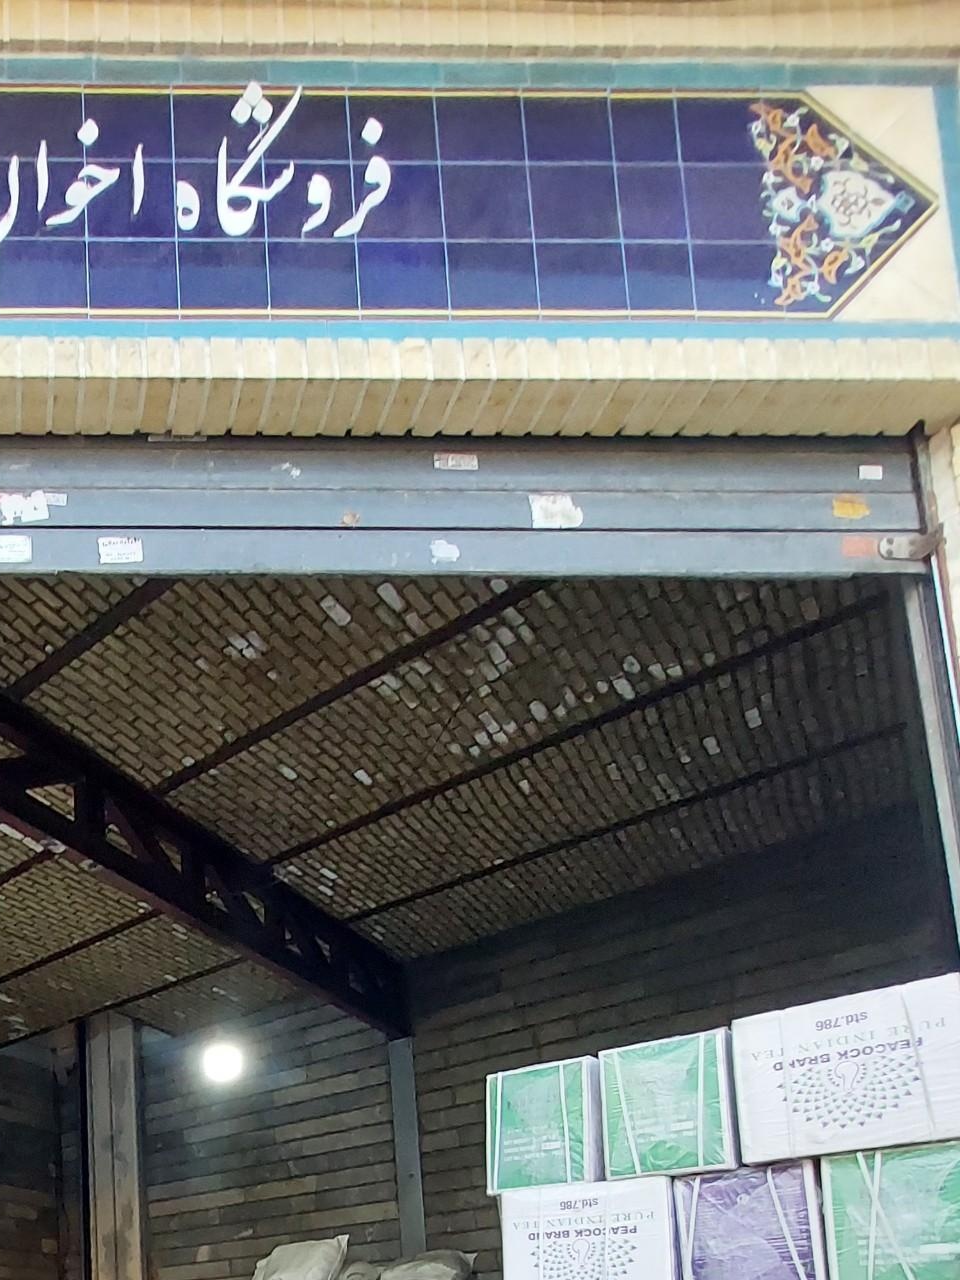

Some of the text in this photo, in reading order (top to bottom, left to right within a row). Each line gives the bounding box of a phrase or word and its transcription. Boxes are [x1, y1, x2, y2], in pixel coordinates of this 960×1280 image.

[176, 80, 394, 239] فروشگاه
[815, 1011, 868, 1032] std.786
[799, 1031, 876, 1052] INDIAN
[751, 1048, 785, 1062] TEA
[559, 1198, 599, 1211] std.786
[512, 1220, 540, 1231] TEA
[546, 1214, 605, 1228] INDIAN
